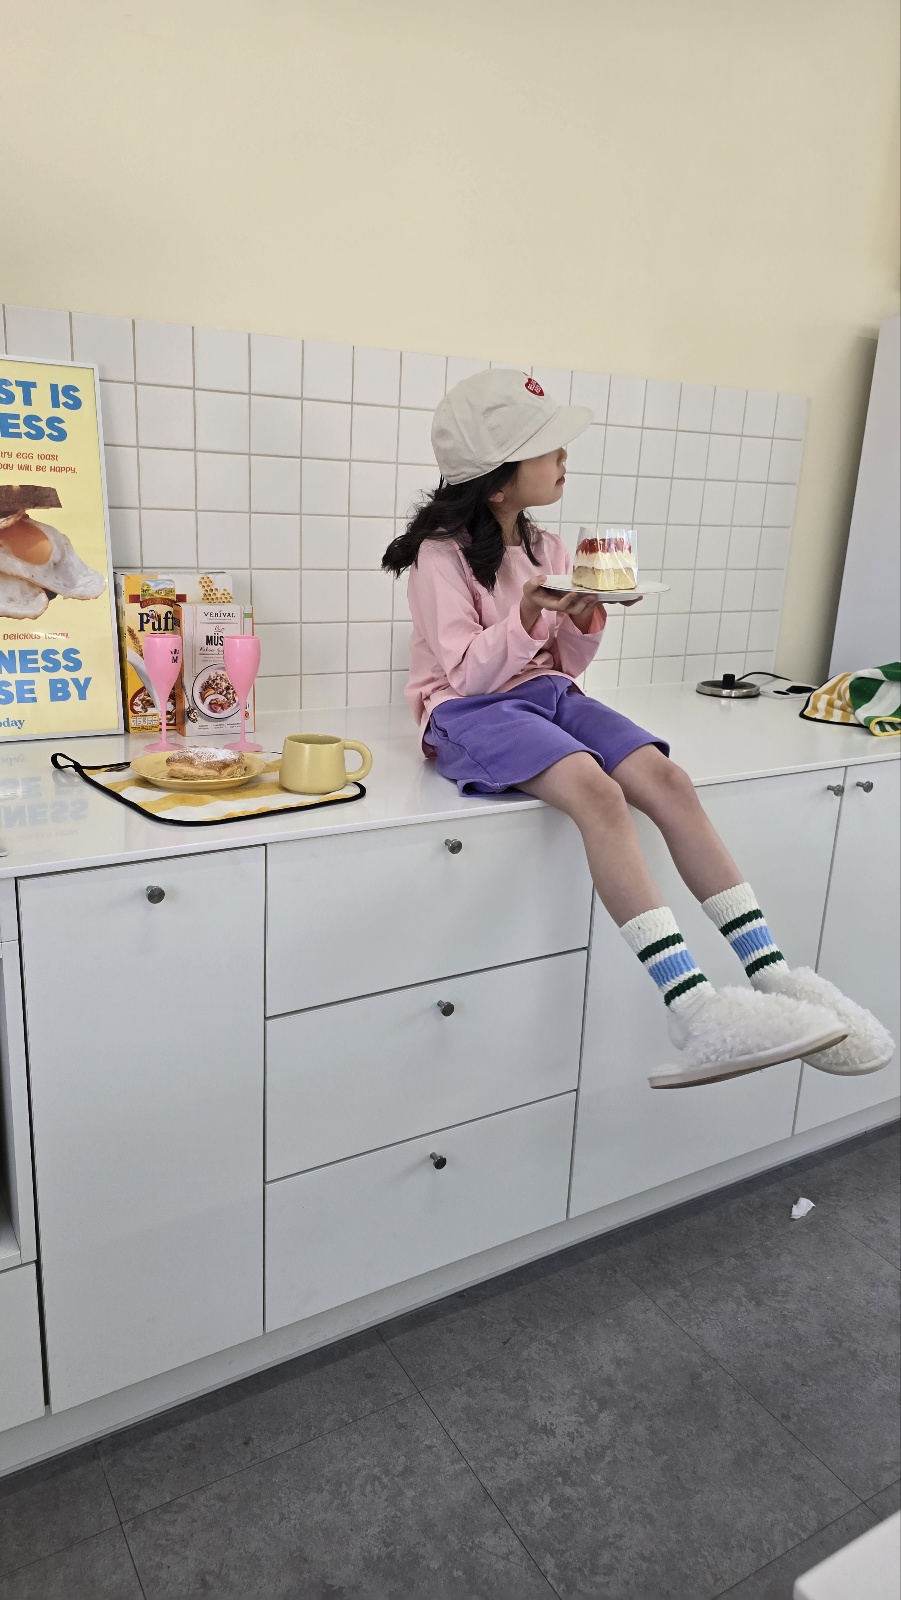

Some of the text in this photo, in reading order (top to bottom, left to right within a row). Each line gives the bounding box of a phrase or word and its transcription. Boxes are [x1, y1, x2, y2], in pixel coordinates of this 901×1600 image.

[0, 378, 82, 411] ST IS
[0, 413, 67, 442] ESS
[1, 451, 13, 459] try
[37, 453, 59, 461] toast
[0, 648, 82, 674] NESS
[0, 677, 92, 705] SE BY
